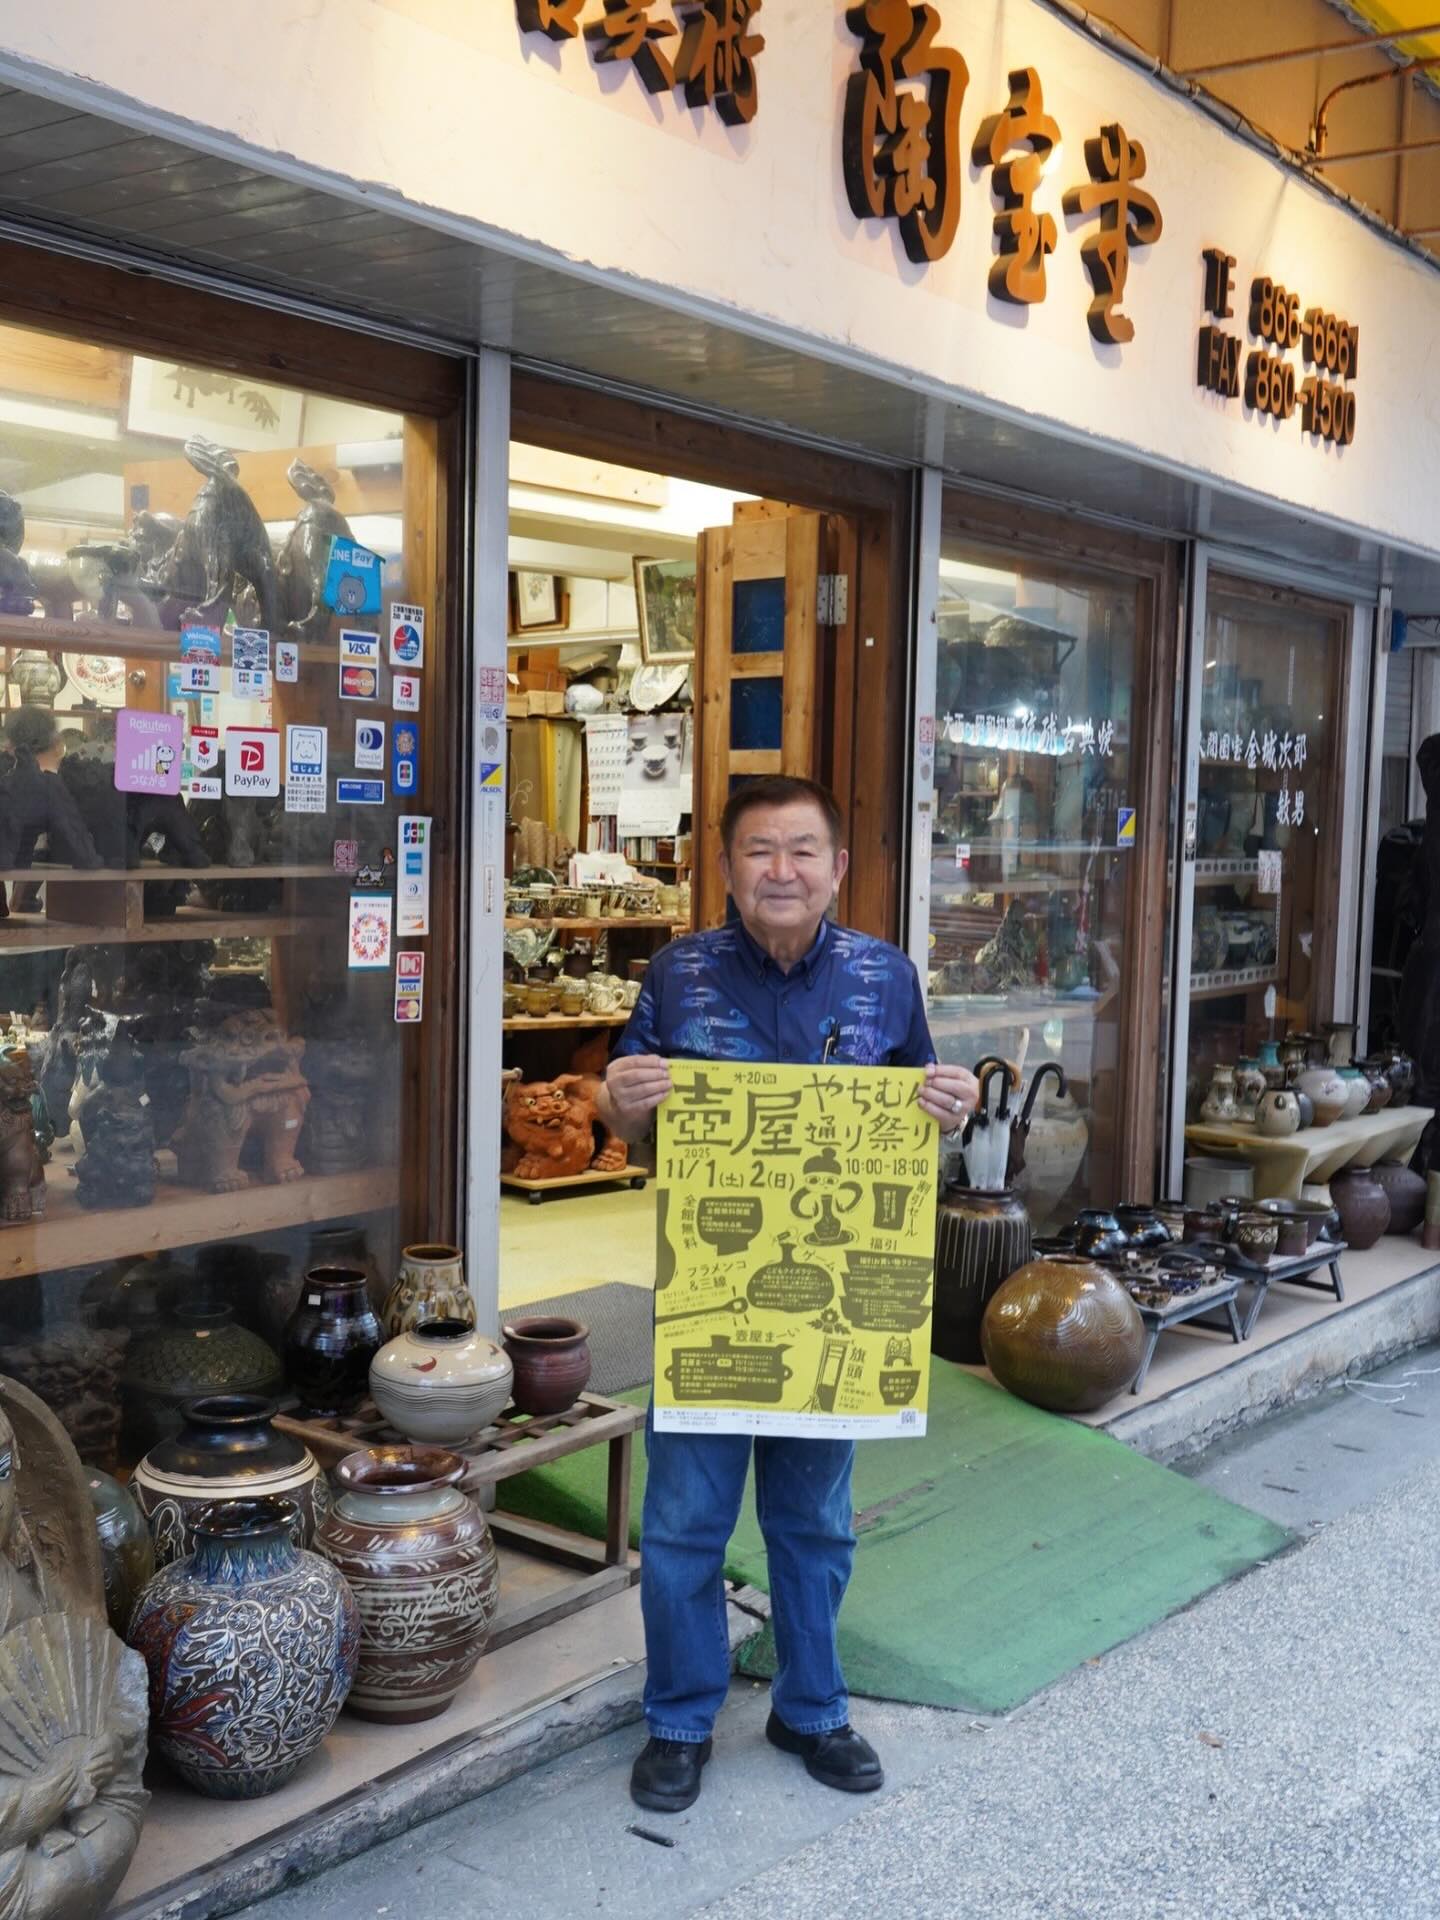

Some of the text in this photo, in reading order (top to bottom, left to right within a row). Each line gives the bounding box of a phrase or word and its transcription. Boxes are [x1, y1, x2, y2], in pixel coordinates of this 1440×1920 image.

[1198, 325, 1356, 445] FAX 860-1500
[349, 642, 370, 655] VISA
[130, 717, 171, 733] Rakuten
[197, 755, 210, 764] Pay
[292, 763, 321, 774] ほじょ犬
[234, 774, 271, 788] PayPay
[401, 983, 417, 993] VISA
[804, 1111, 932, 1153] 通り祭り
[684, 1147, 711, 1159] 2025
[846, 1158, 929, 1177] 10:00-18:00
[687, 1260, 747, 1278] フラメンコ
